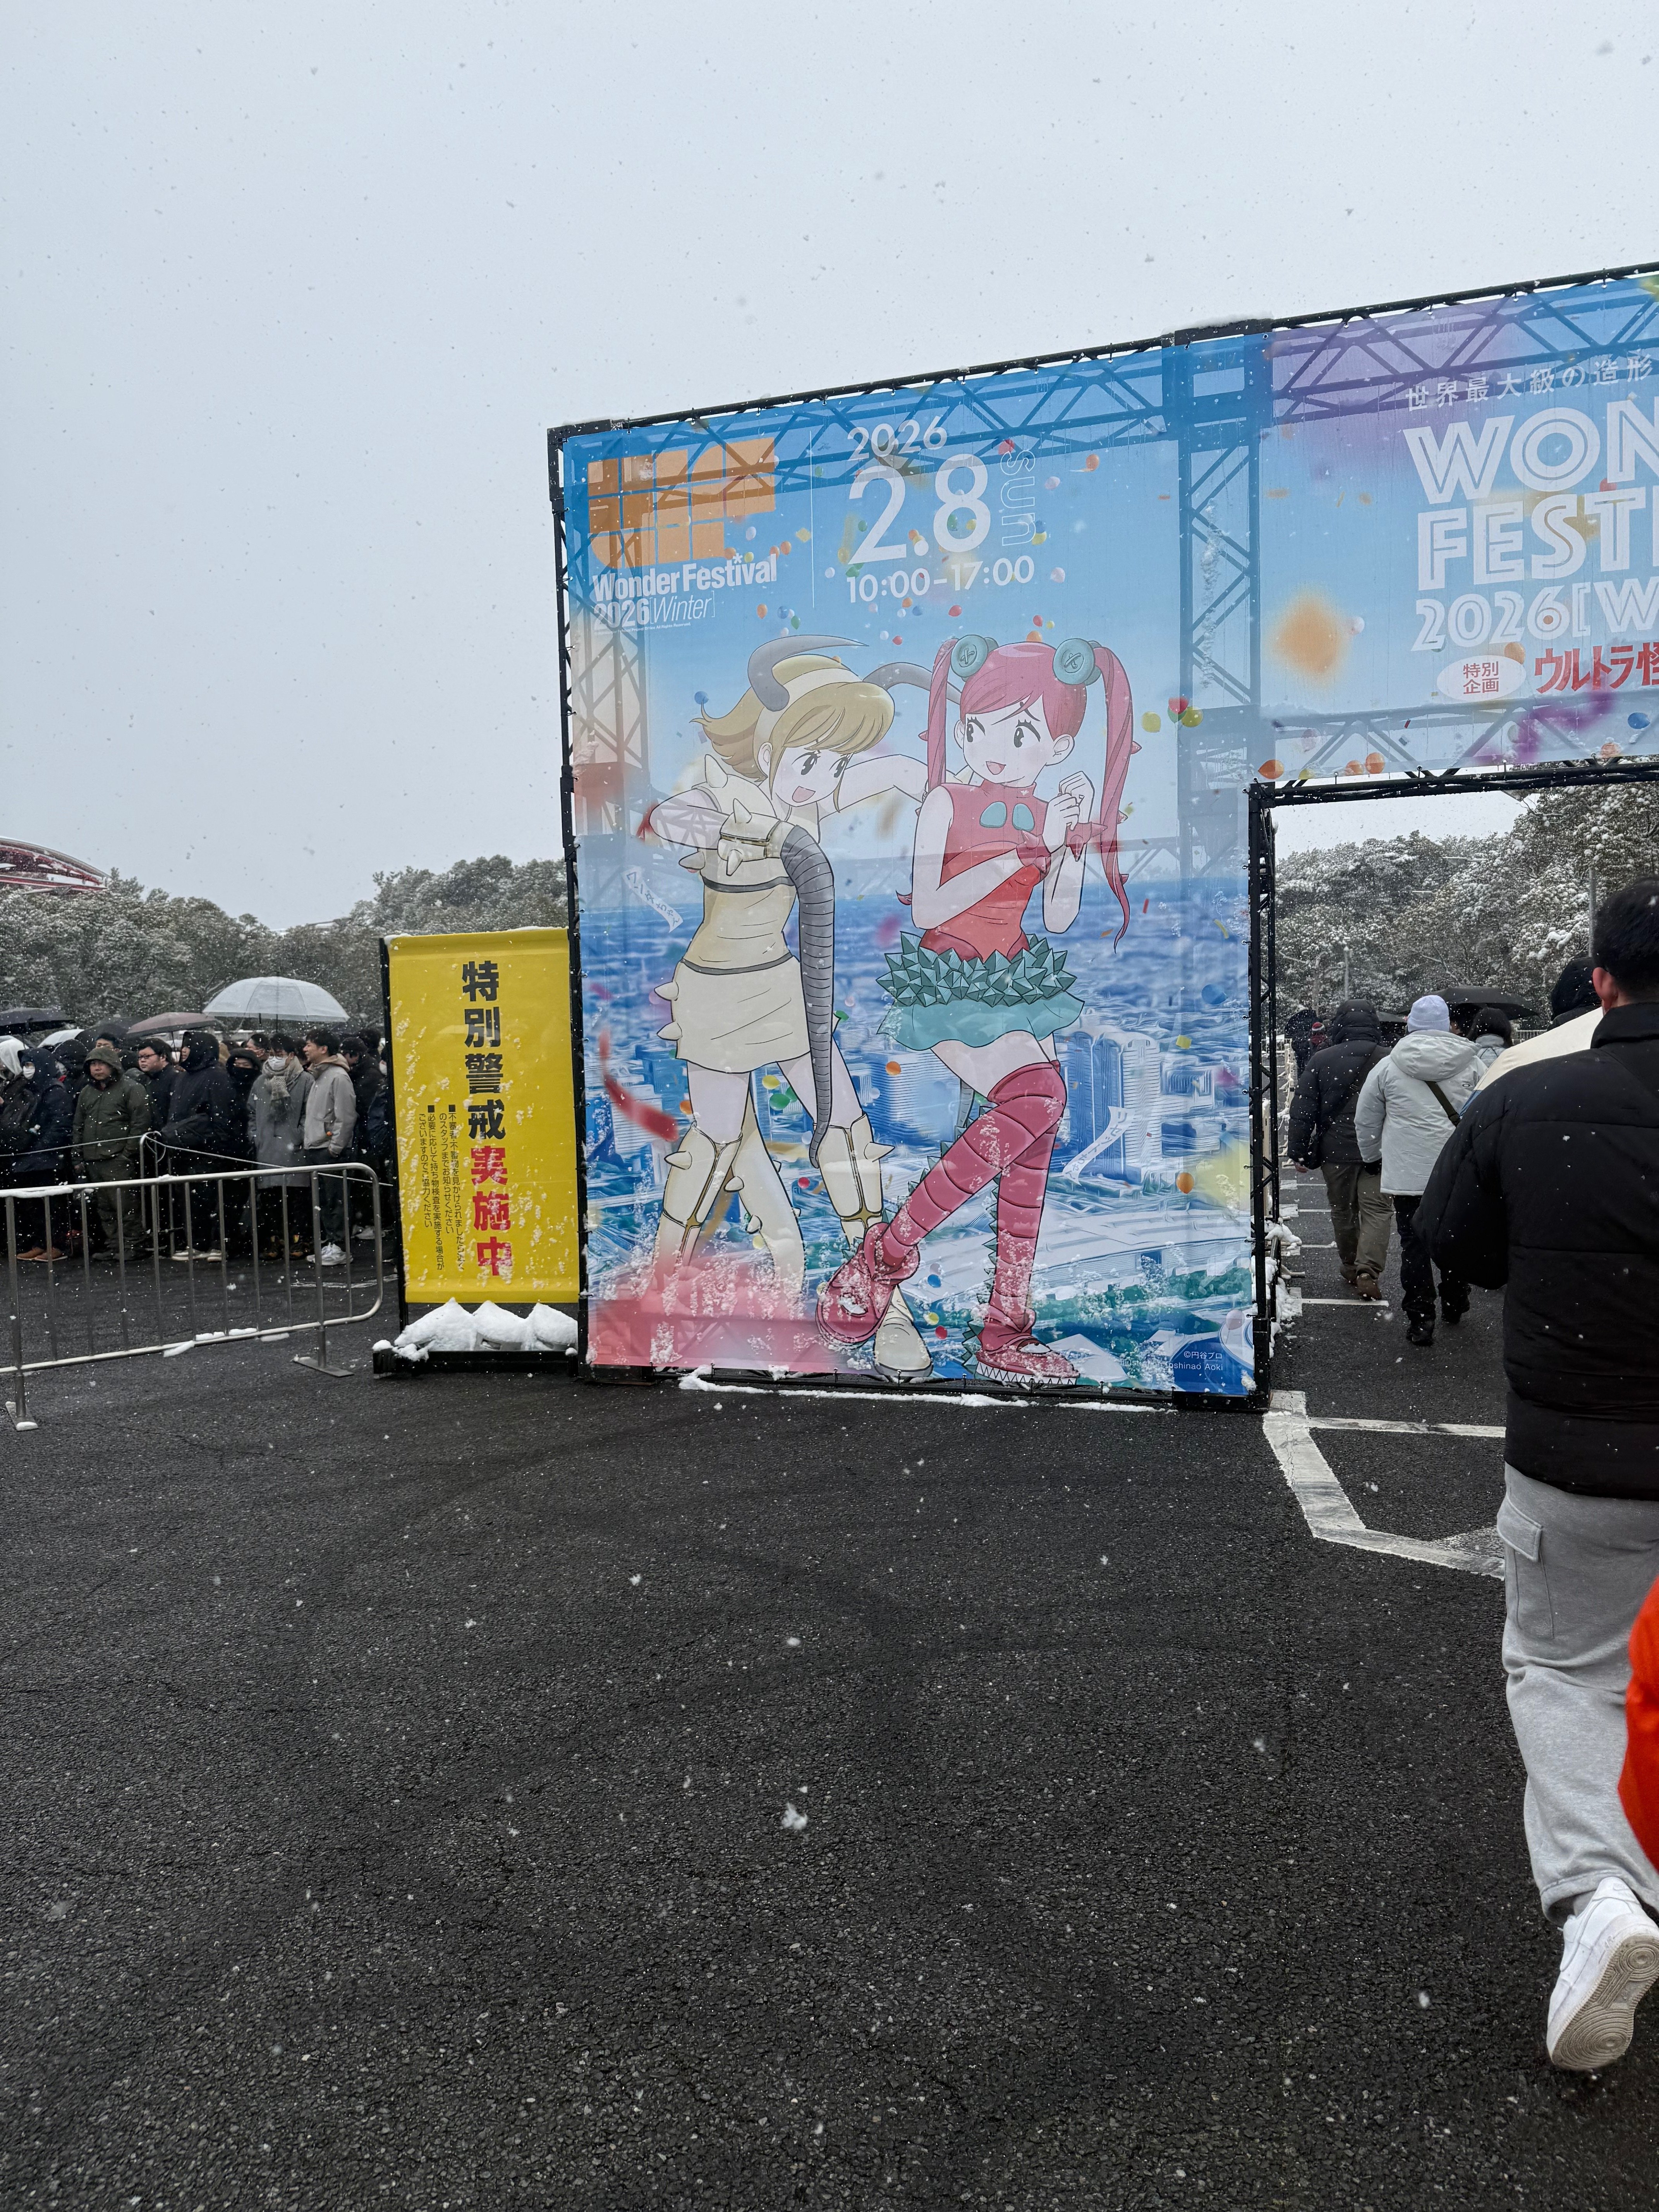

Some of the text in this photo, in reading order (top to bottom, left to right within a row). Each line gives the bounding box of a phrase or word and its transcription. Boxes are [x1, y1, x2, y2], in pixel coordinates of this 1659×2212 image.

[1405, 354, 1652, 412] 世界最大級の造形
[847, 415, 947, 461] 2026
[1403, 396, 1659, 504] WON
[848, 453, 991, 565] 2.8
[1418, 485, 1659, 591] FEST
[847, 555, 1035, 603] 10:00-17:00
[1463, 661, 1499, 678] 特別
[1463, 678, 1499, 694] 企画
[626, 872, 680, 927] ワンダちゃん
[462, 960, 513, 1276] 特別警戒実施中
[1065, 1111, 1127, 1180] リセットちゃん
